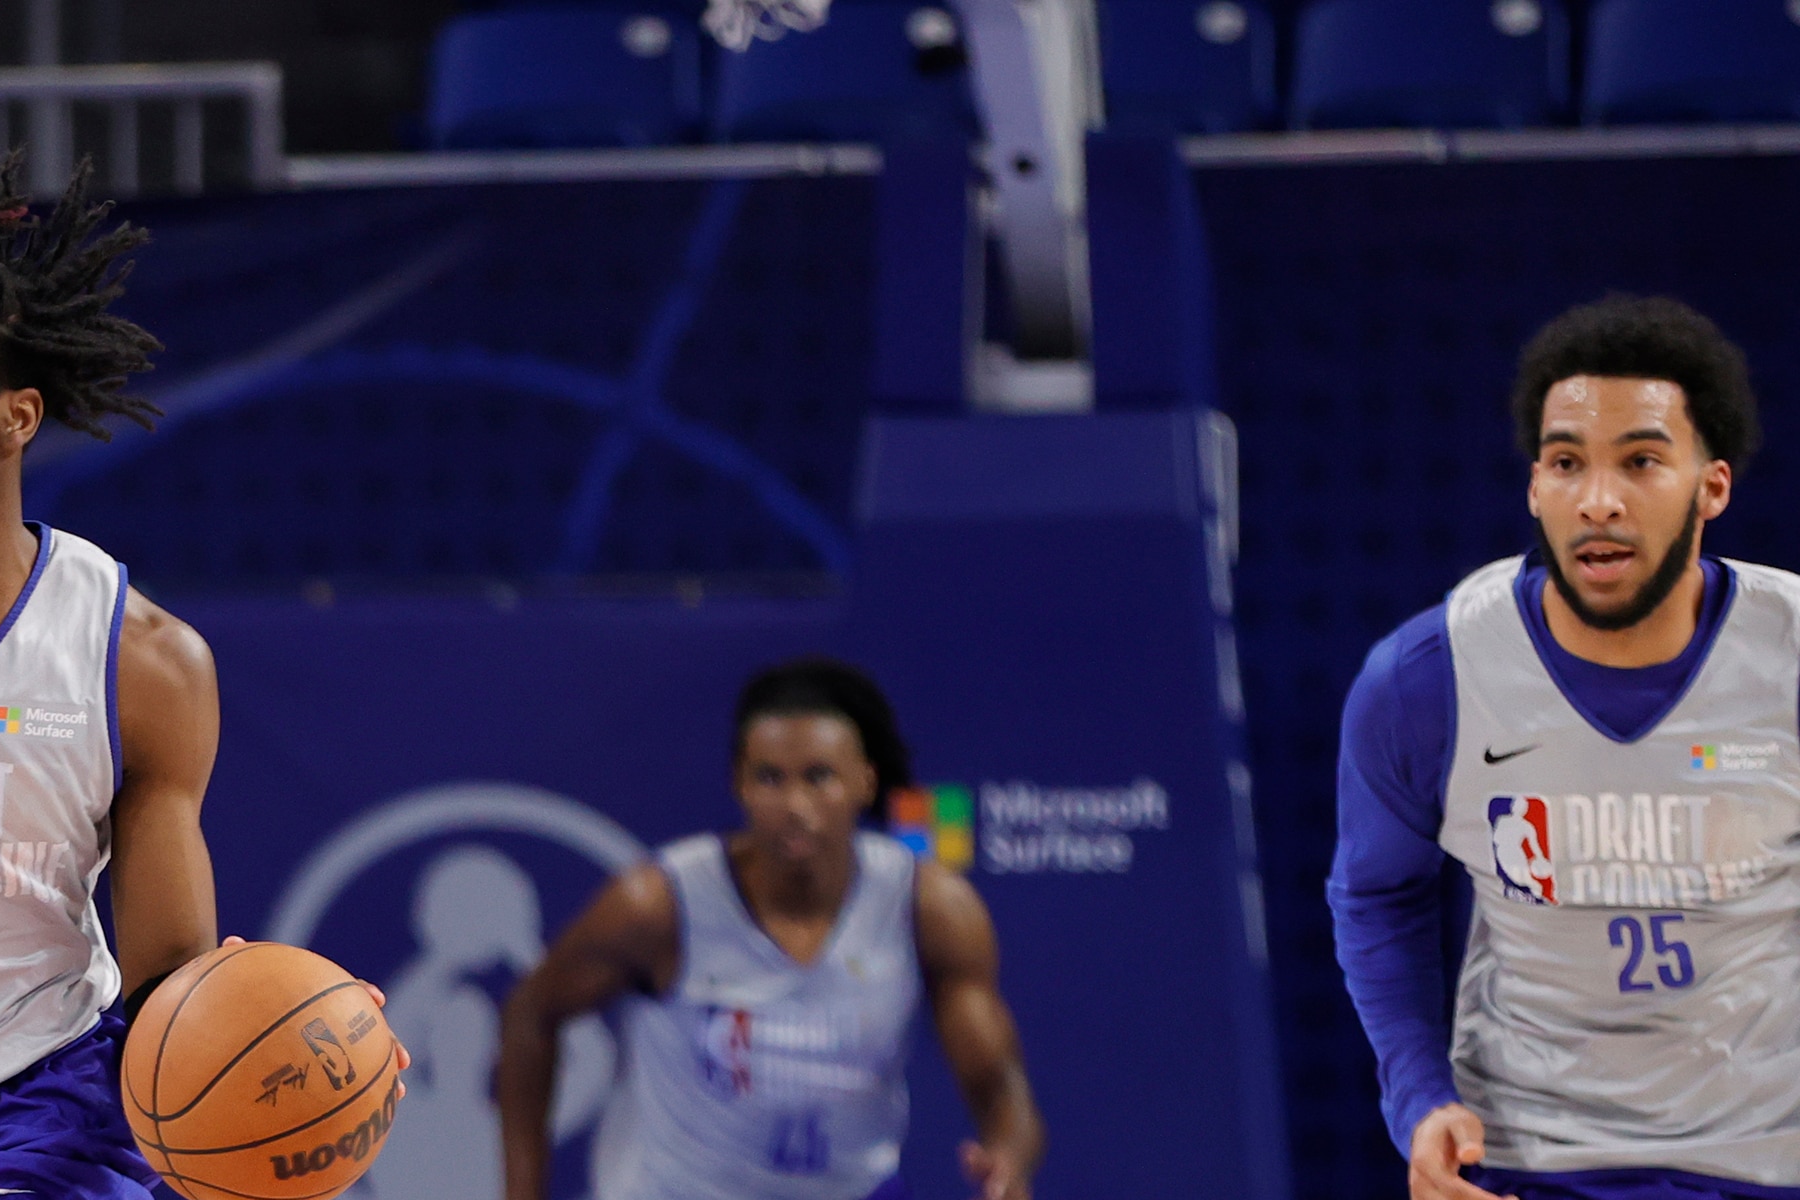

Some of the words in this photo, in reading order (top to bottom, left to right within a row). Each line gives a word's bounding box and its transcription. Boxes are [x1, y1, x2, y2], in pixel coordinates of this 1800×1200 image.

[24, 723, 75, 738] Surface
[25, 707, 88, 725] Microsoft
[1565, 792, 1711, 864] DRAFT
[1608, 913, 1694, 993] 25
